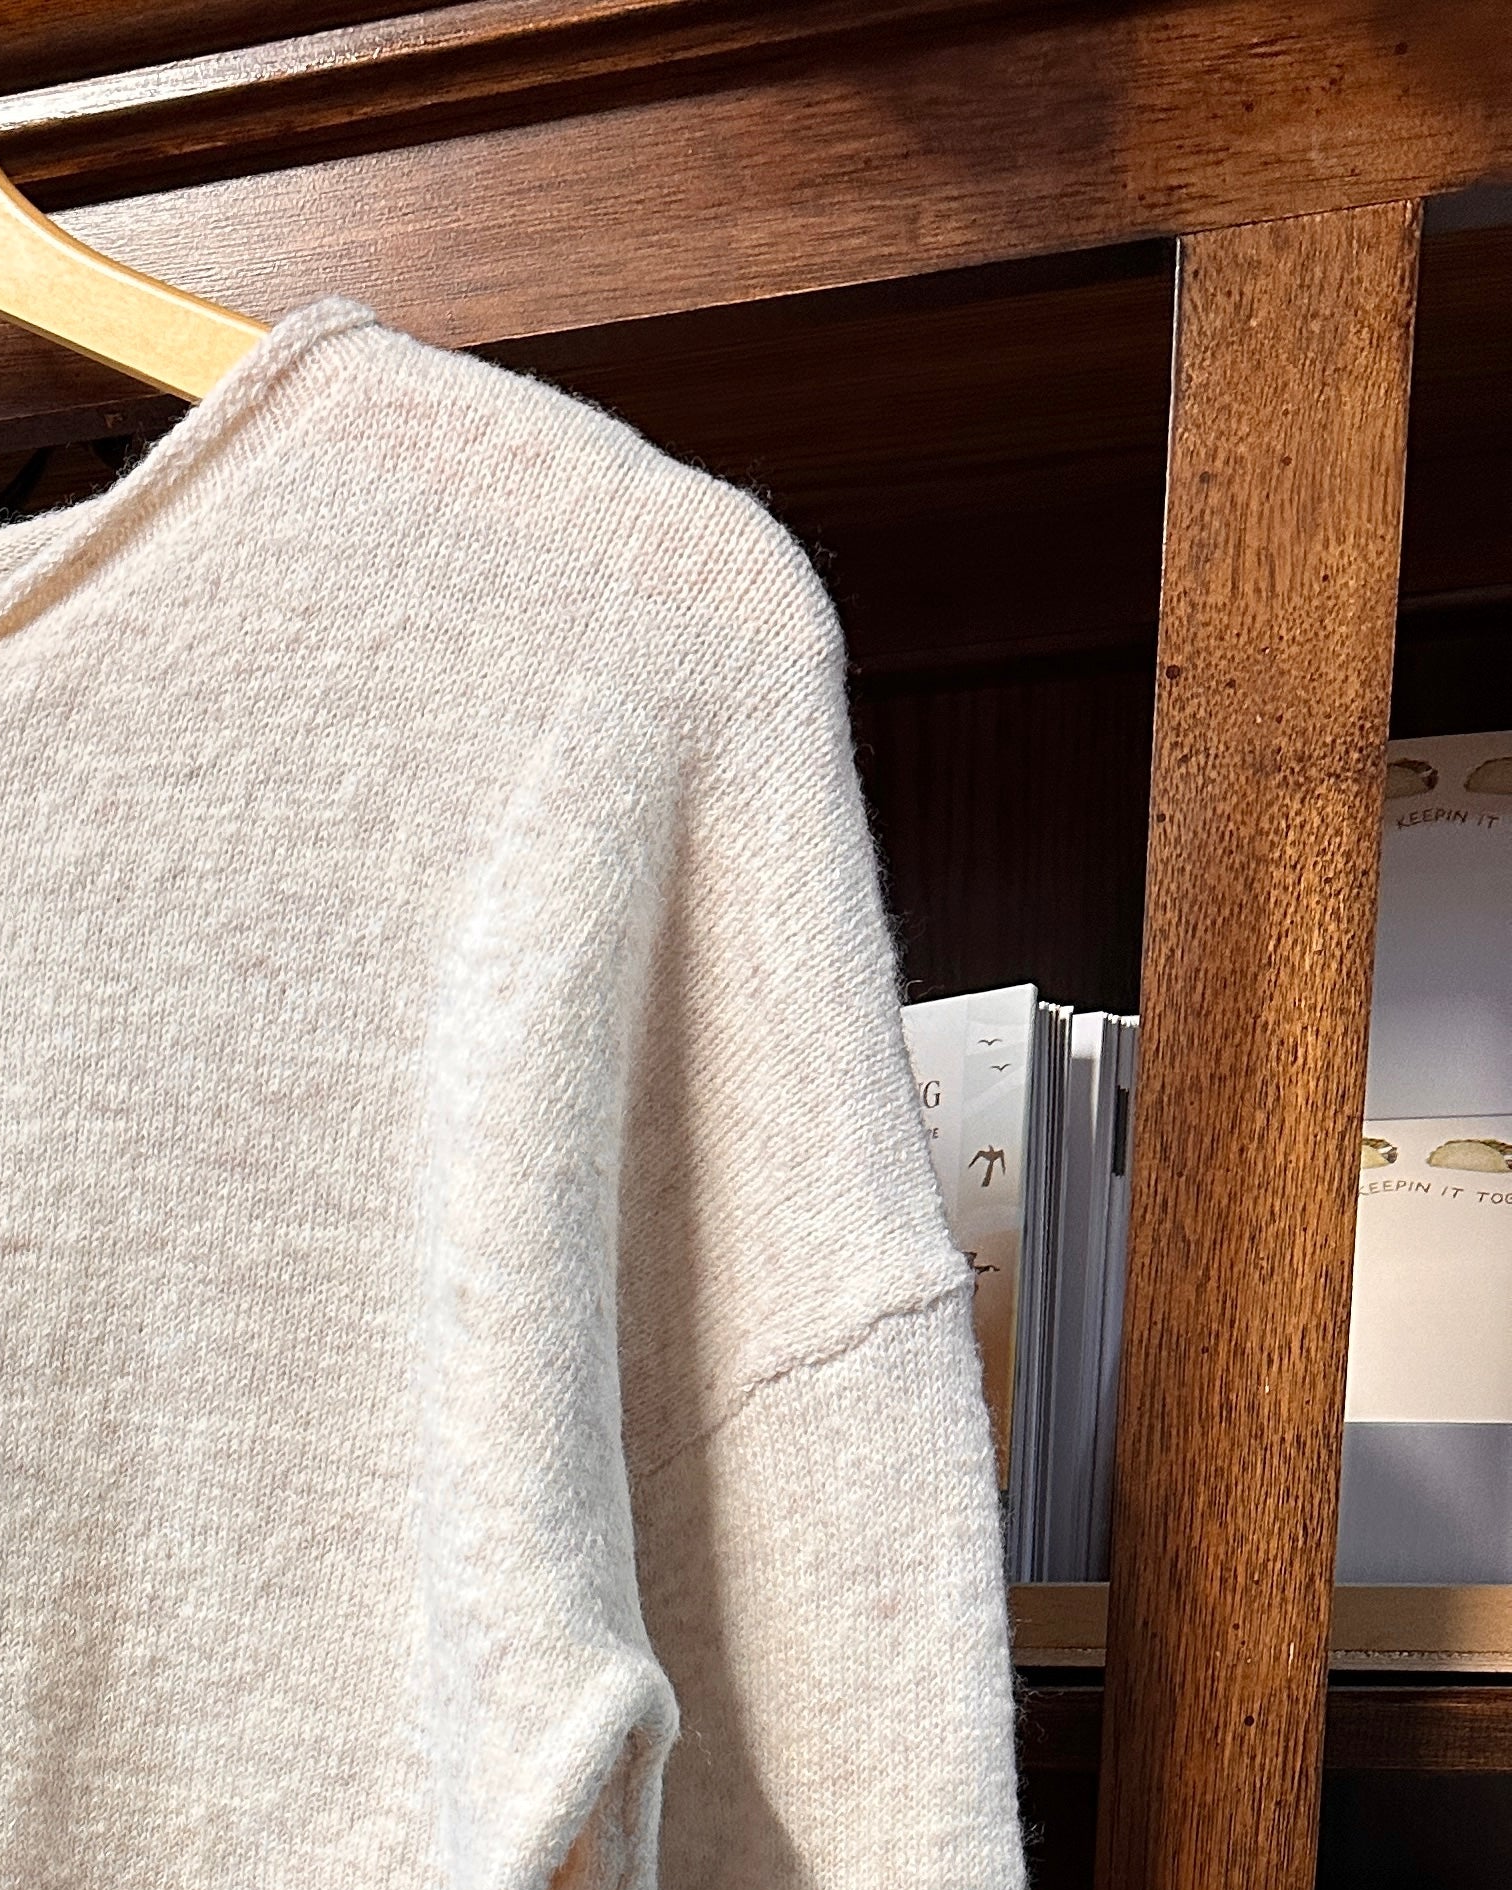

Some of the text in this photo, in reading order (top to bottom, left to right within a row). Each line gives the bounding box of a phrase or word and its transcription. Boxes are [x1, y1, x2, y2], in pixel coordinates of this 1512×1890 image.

[1397, 808, 1499, 829] KEEPIN IT
[1441, 1186, 1464, 1199] IT
